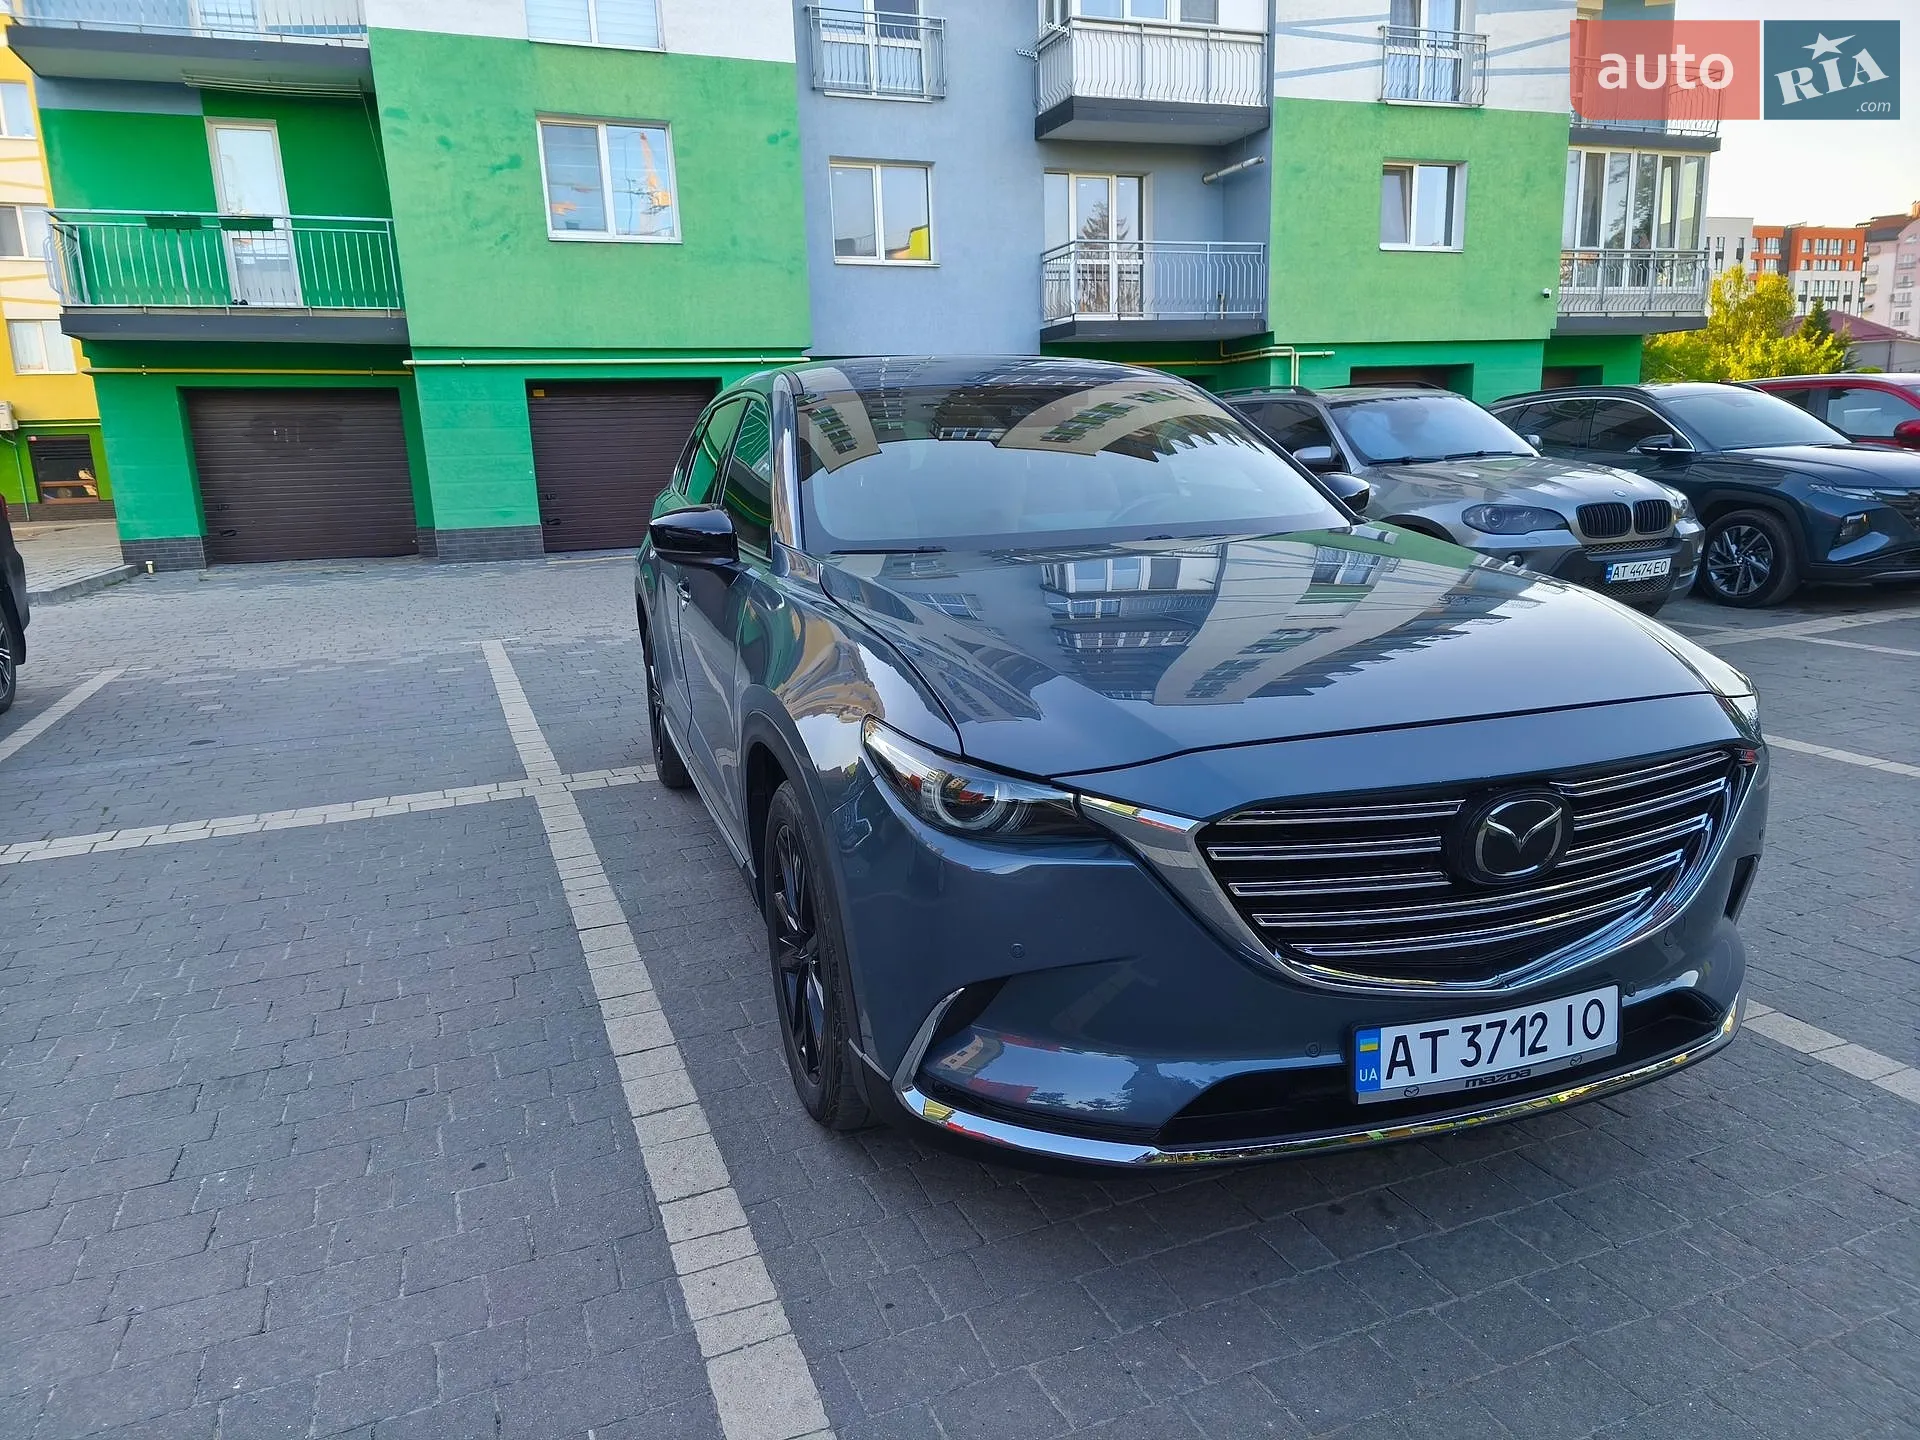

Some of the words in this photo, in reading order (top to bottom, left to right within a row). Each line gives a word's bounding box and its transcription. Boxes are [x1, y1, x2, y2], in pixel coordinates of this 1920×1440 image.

[1613, 566, 1628, 578] AT
[1630, 563, 1652, 577] 4474
[1386, 1029, 1450, 1080] AT
[1460, 1012, 1548, 1067] 3712
[1359, 1068, 1378, 1082] UA
